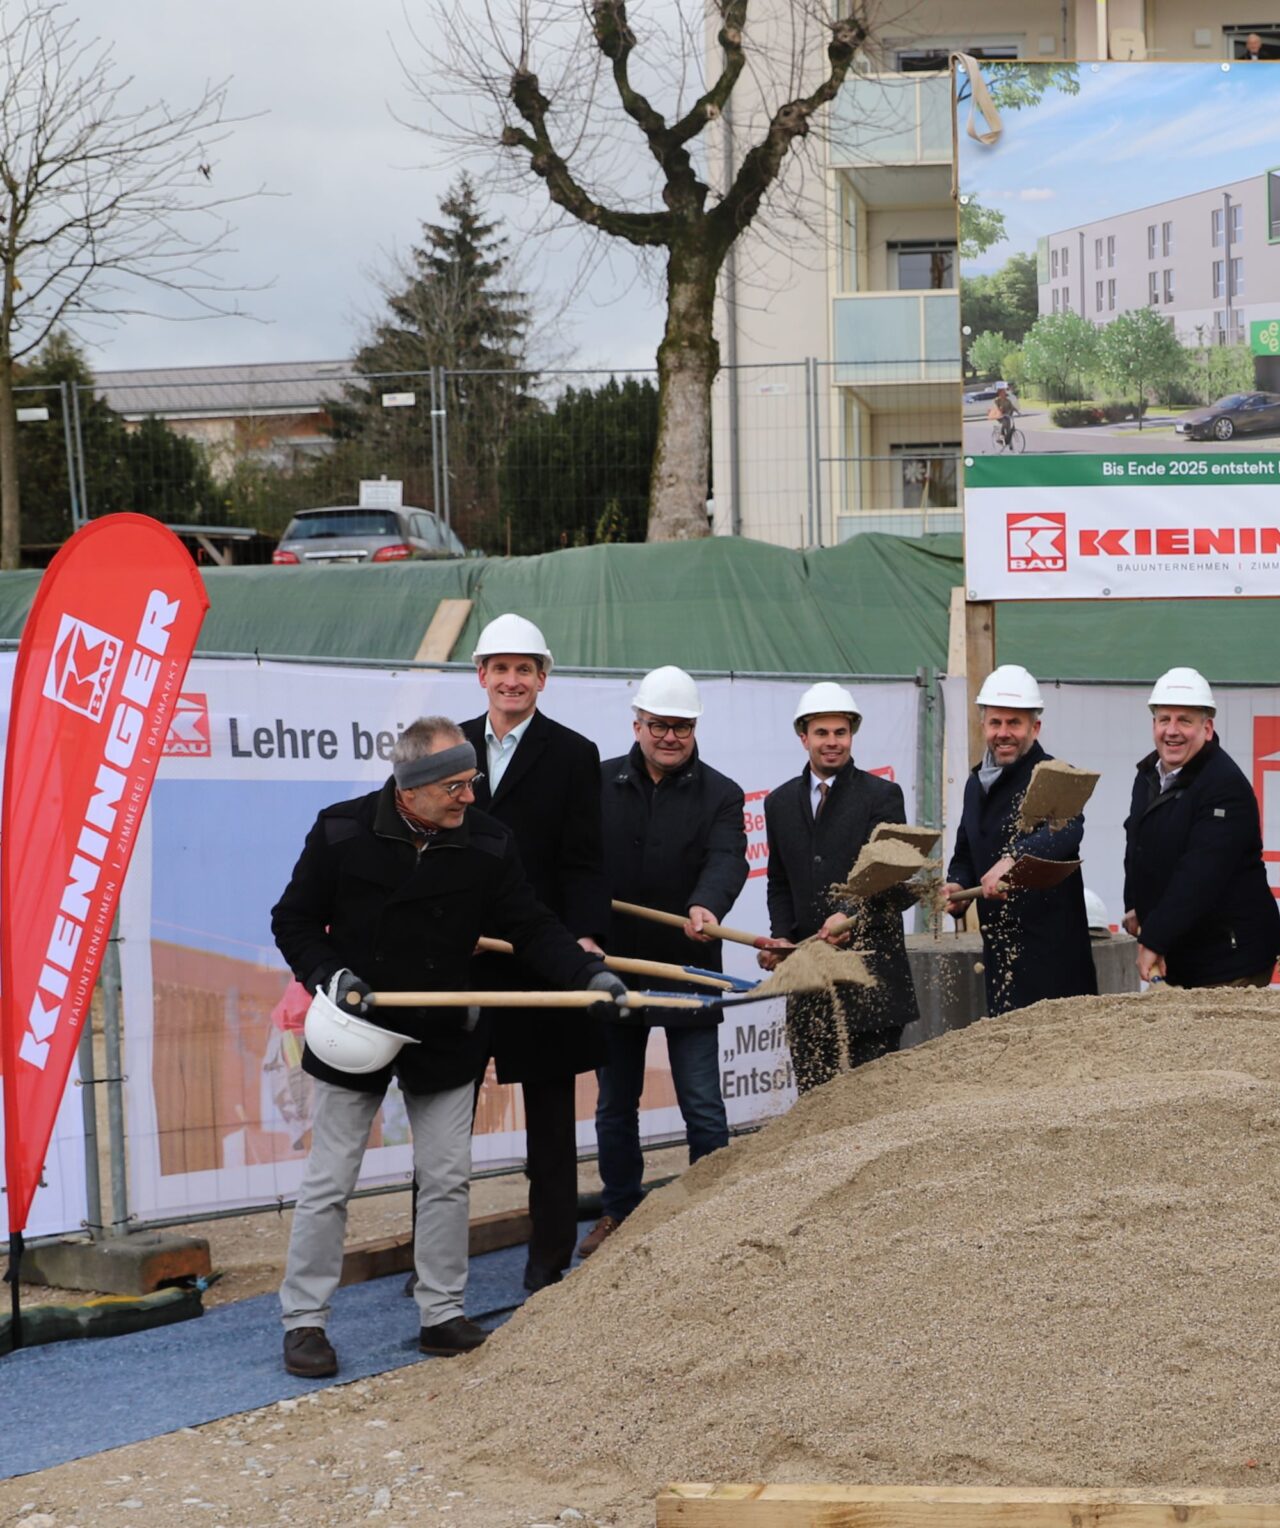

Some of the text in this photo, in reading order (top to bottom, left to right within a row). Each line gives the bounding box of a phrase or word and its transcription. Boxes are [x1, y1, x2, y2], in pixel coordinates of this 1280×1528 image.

[1102, 462, 1124, 476] Bis
[1128, 461, 1166, 475] Ende
[1169, 461, 1208, 475] 2025
[1211, 461, 1275, 475] entsteht
[1010, 559, 1064, 570] BAU
[1116, 562, 1230, 572] BAUUNTERNEHMEN
[90, 638, 118, 717] BAU
[229, 717, 338, 761] Lehre
[18, 589, 181, 1071] KIENINGER
[68, 660, 179, 1027] BAUUNTERNEHMEN ZIMMEREI BAUMARKT
